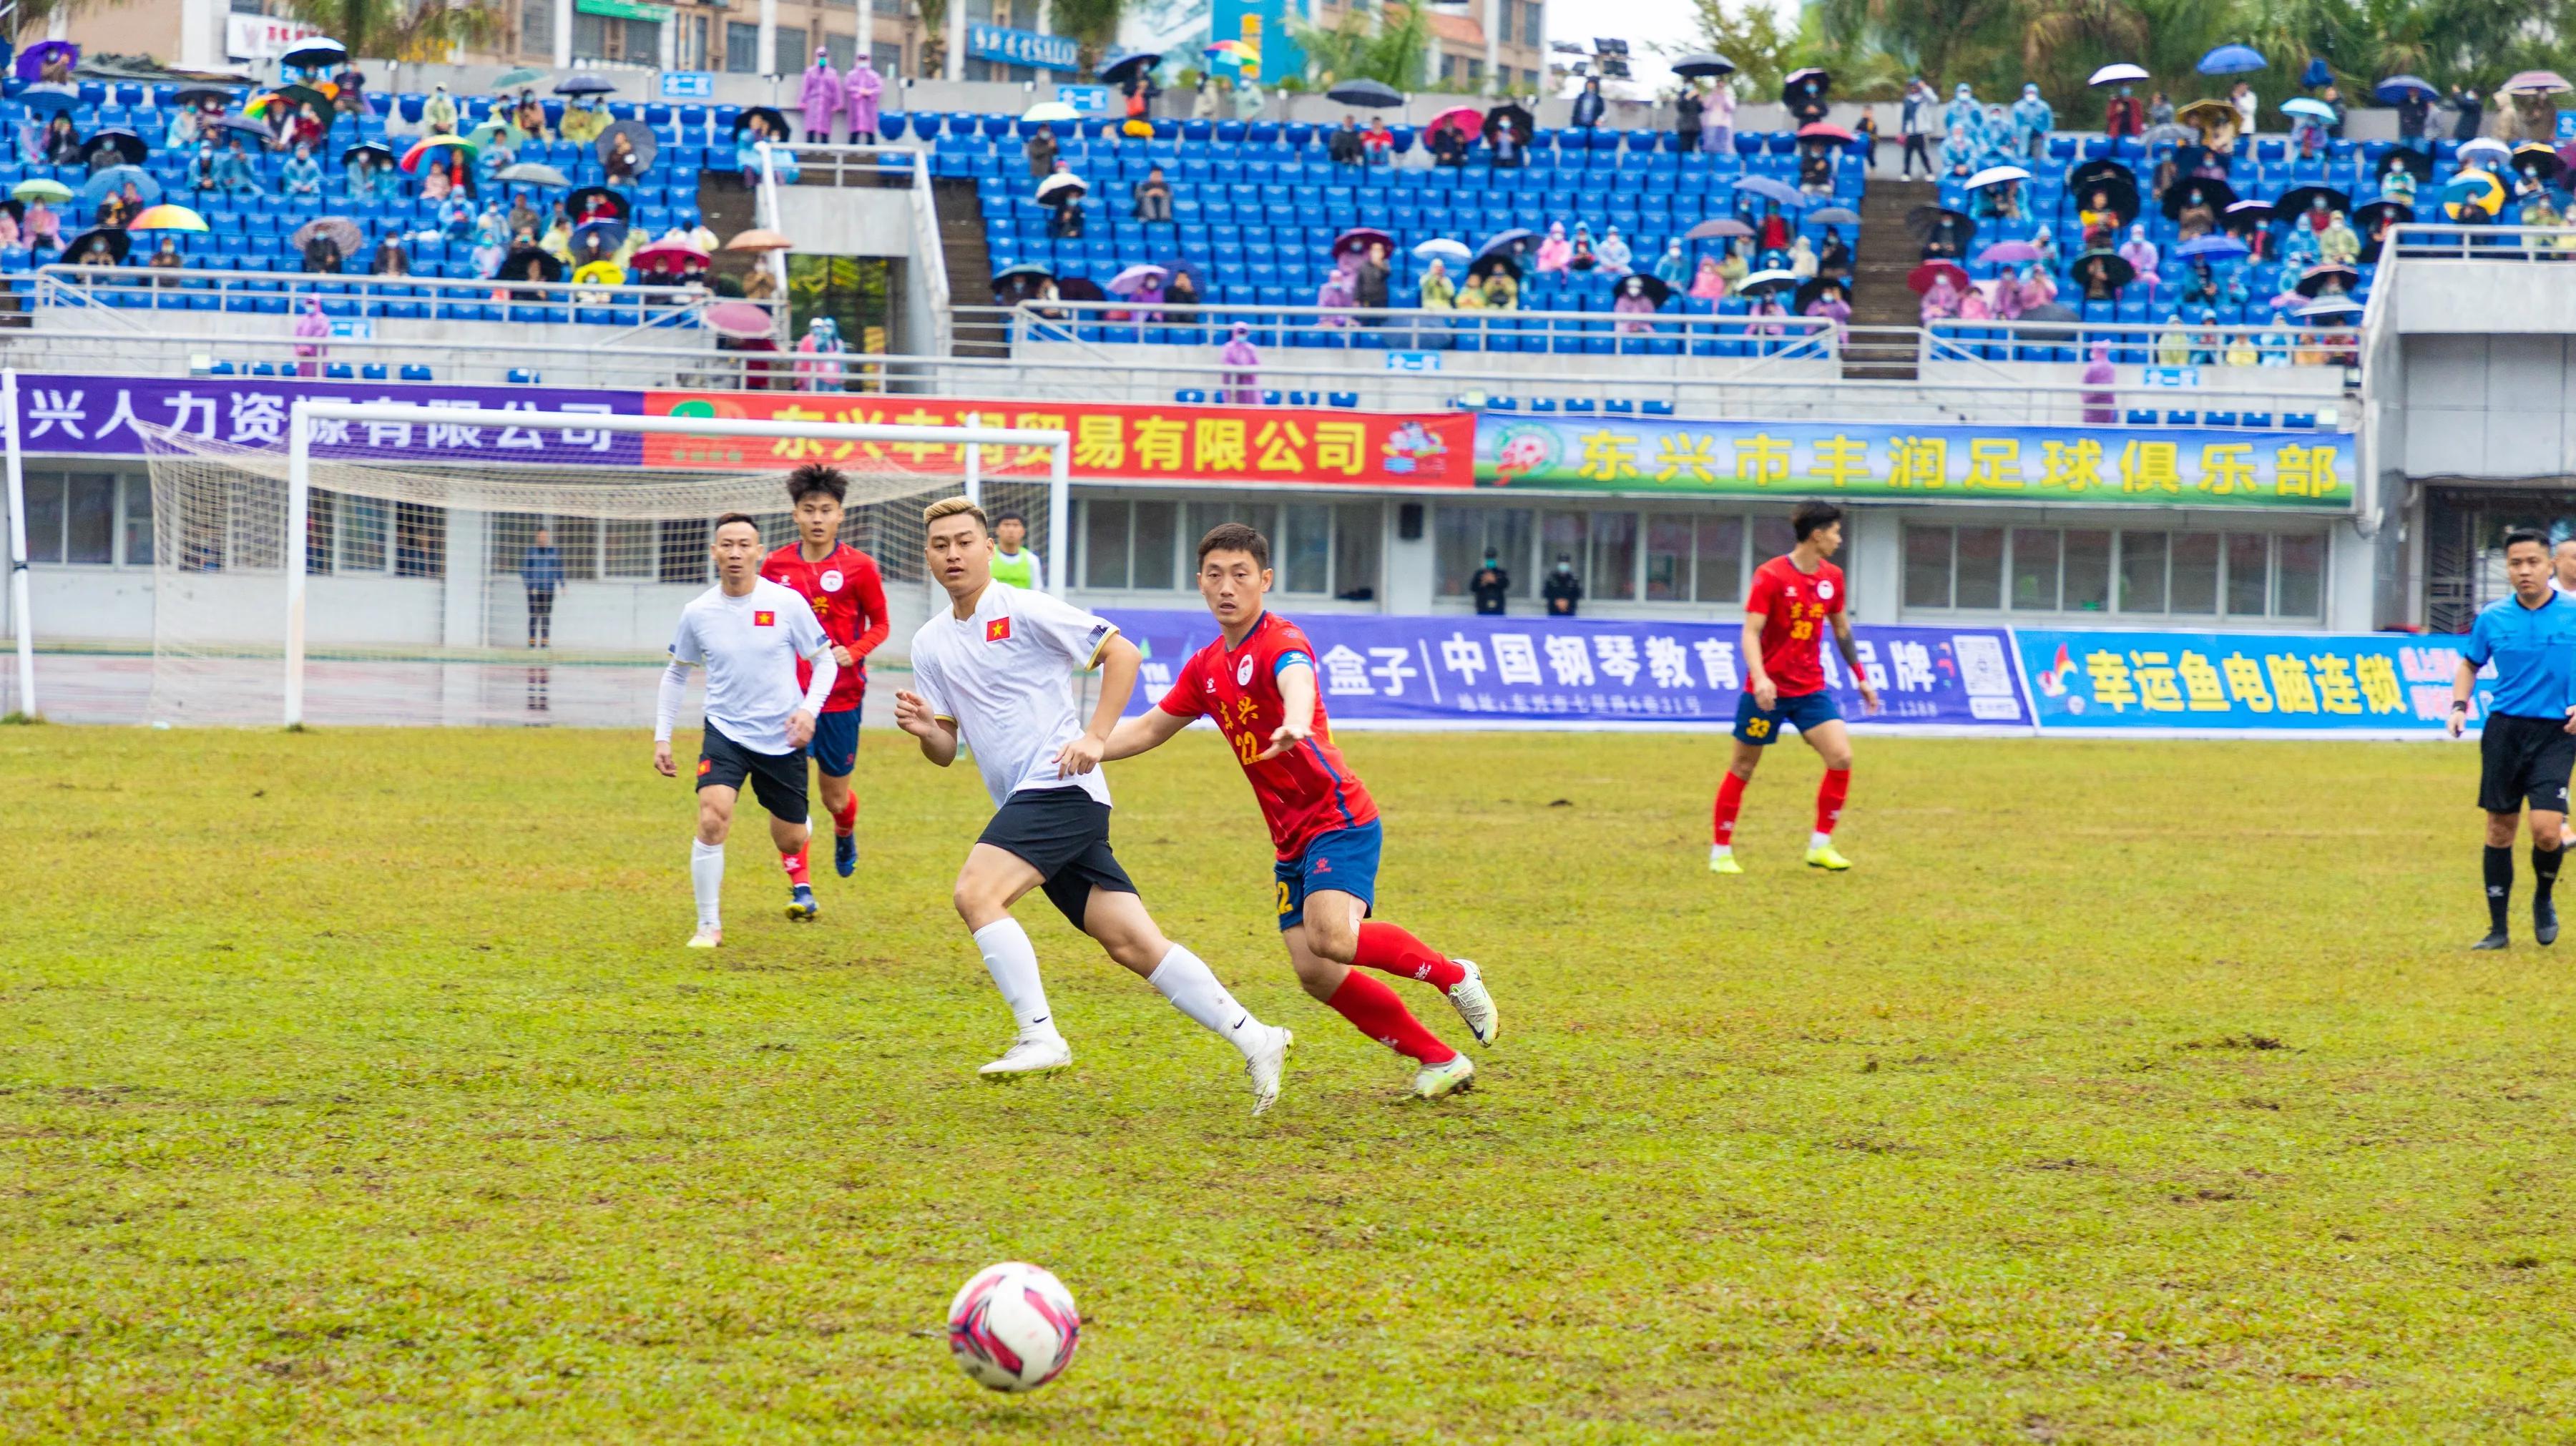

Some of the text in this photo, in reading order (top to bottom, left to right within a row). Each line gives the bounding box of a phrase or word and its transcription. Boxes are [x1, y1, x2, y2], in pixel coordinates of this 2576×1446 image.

[0, 388, 613, 453] 兴人力资源有限公司
[1577, 429, 2339, 498] 东兴市丰润足球俱乐部
[1790, 619, 1813, 641] 33
[1440, 631, 1936, 693] 中国钢琴教育品牌
[2085, 649, 2407, 714] 幸运鱼电脑连锁
[1235, 731, 1265, 765] 22
[1745, 717, 1771, 739] 33
